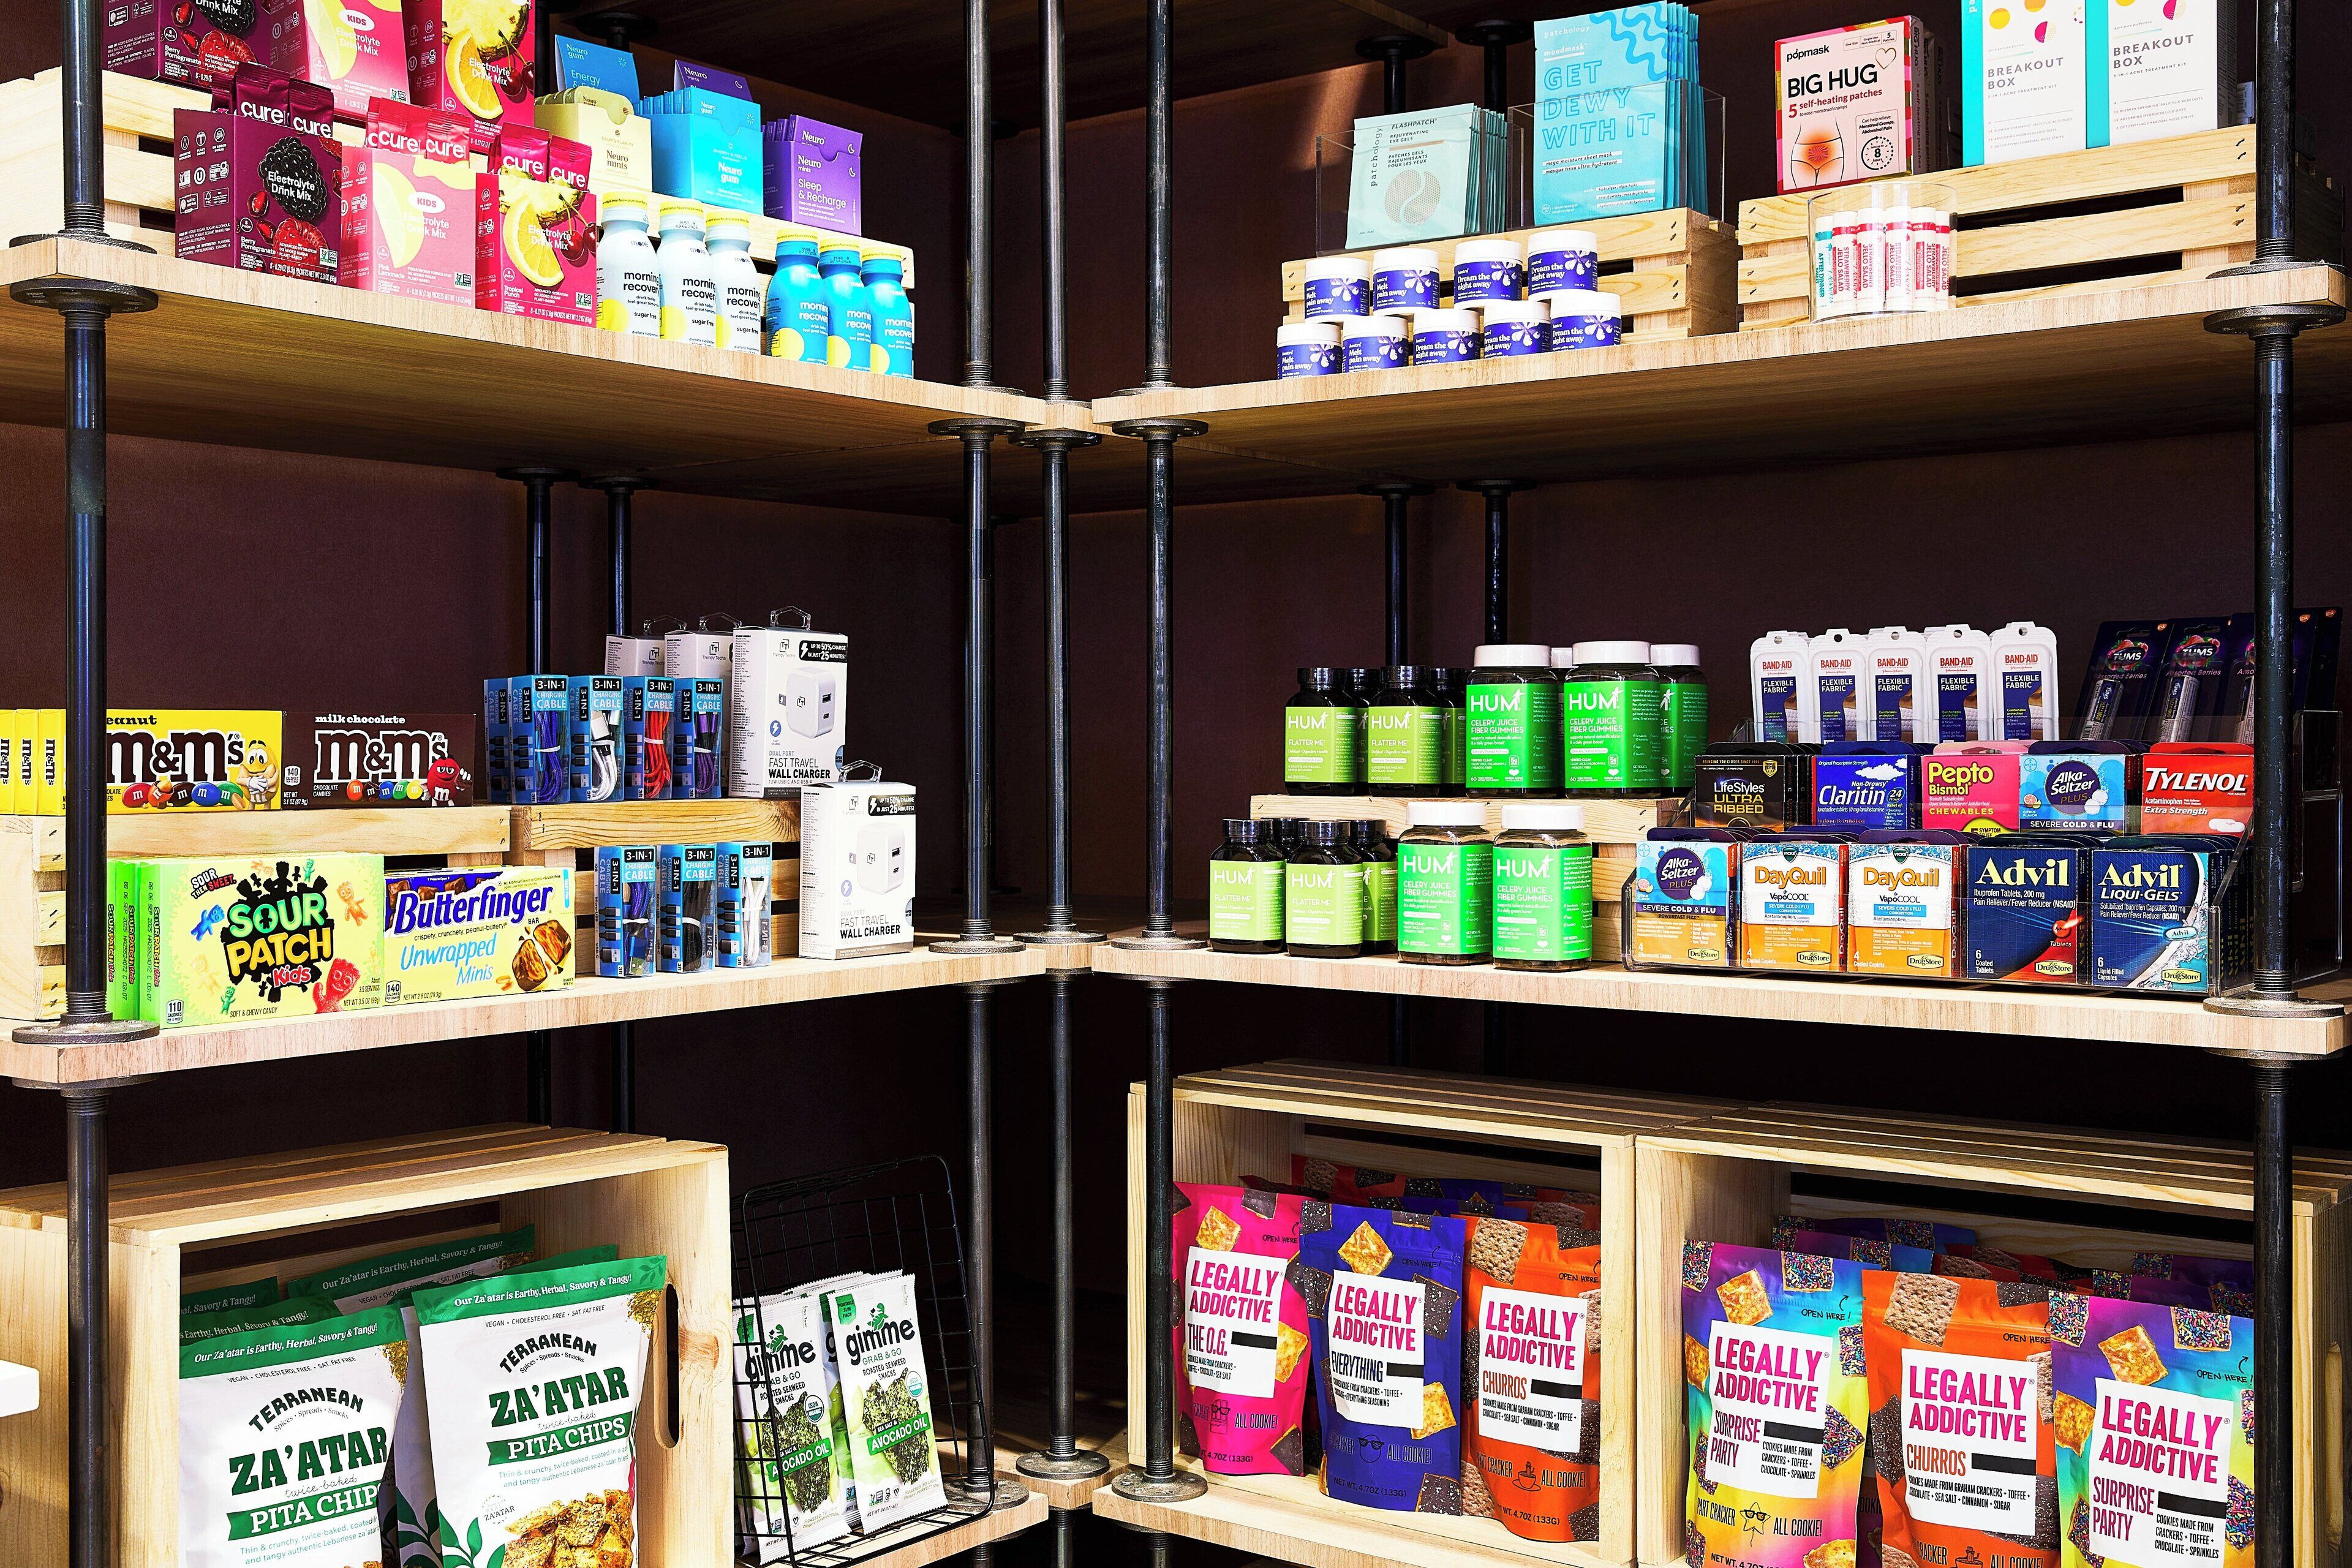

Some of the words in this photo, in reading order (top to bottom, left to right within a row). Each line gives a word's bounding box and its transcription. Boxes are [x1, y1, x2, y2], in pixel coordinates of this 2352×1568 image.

[1544, 25, 1590, 38] patchology
[567, 43, 588, 55] Neuro
[1544, 44, 1585, 56] moodmask
[1787, 45, 1830, 62] popmask
[2113, 33, 2195, 57] BREAKOUT
[568, 51, 584, 61] gum
[2113, 53, 2143, 69] BOX
[571, 70, 600, 85] Energy
[1544, 60, 1602, 91] GET
[1788, 74, 1822, 98] BIG
[1829, 64, 1877, 90] HUG
[1544, 86, 1633, 121] DEWY
[1789, 104, 1797, 118] 5
[1800, 94, 1848, 109] self-heating
[1850, 88, 1882, 102] patches
[241, 102, 284, 124] cure
[1392, 119, 1434, 129] FLASHPATCH
[1542, 118, 1616, 149] WITH
[1627, 113, 1656, 138] IT
[606, 149, 628, 162] Neuro
[1371, 128, 1383, 186] patchology
[1389, 154, 1428, 163] RAJEUNISSANTS
[1874, 148, 1881, 158] 8
[503, 155, 544, 175] cure
[607, 159, 628, 170] mints
[798, 156, 822, 168] Neuro
[798, 165, 811, 173] mints
[1578, 159, 1618, 170] ultra-hydratant
[268, 172, 315, 191] Electrolyte
[798, 178, 823, 194] Sleep
[271, 183, 295, 198] Drink
[296, 189, 312, 202] Mix
[798, 190, 807, 199] &
[807, 190, 846, 209] Recharge
[417, 197, 437, 208] KIDS
[241, 237, 257, 246] Berry
[241, 243, 276, 255] Pomegranate
[504, 285, 524, 294] Tropical
[504, 290, 520, 299] Punch
[1763, 661, 1792, 670] BAND-AID
[537, 680, 565, 691] 3-IN-1
[537, 699, 566, 709] CABLE
[1471, 692, 1519, 712] HUM
[347, 715, 405, 725] chocolate
[769, 759, 791, 768] FAST
[794, 758, 818, 768] TRAVEL
[769, 769, 791, 778] WALL
[793, 768, 830, 779] CHARGER
[1929, 763, 1995, 789] Pepto
[2146, 768, 2245, 791] TYLENOL
[1714, 782, 1764, 794] LifeStyles
[1819, 786, 1885, 805] Claritin
[1929, 782, 1968, 795] Bismol
[1714, 794, 1763, 804] ULTRA
[1714, 804, 1763, 813] RIBBED
[2145, 807, 2166, 815] Extra
[2168, 807, 2207, 816] Strength
[1665, 857, 1692, 869] Alka-
[1975, 856, 2069, 886] Advil
[190, 869, 217, 888] SOUR
[1662, 867, 1697, 879] Seltzer
[1755, 866, 1826, 886] DayQuil
[2098, 863, 2180, 888] Advil
[1670, 880, 1693, 889] PLUS
[191, 888, 208, 899] THEN
[1974, 889, 1999, 898] Ibuprofen
[228, 893, 326, 937] SOUR
[394, 886, 552, 935] Butterfinger
[225, 934, 331, 977] PATCH
[401, 933, 497, 971] Unwrapped
[1910, 958, 1942, 967] DrugStore
[273, 967, 312, 987] Kids
[456, 965, 494, 986] Minis
[168, 1002, 181, 1012] 110
[1262, 1234, 1280, 1243] OPEN
[1191, 1260, 1279, 1297] LEGALLY
[454, 1297, 472, 1307] Our
[514, 1287, 541, 1299] Earthy,
[541, 1283, 568, 1294] Herbal,
[569, 1279, 598, 1292] Savory
[607, 1274, 632, 1286] Tangy!
[1189, 1290, 1272, 1323] ADDICTIVE
[846, 1317, 915, 1365] gimme
[1187, 1323, 1204, 1352] THE
[1206, 1328, 1227, 1356] O.G.
[499, 1333, 597, 1373] TERRANEAN
[863, 1363, 884, 1376] ROASTED
[886, 1358, 906, 1370] SEAWEED
[1332, 1351, 1383, 1382] EVERYTHING
[1483, 1370, 1527, 1400] CHURROS
[872, 1424, 911, 1451] AVOCADO
[913, 1416, 927, 1434] OIL
[1714, 1410, 1761, 1444] SURPRISE
[508, 1436, 563, 1460] PITA
[565, 1417, 627, 1448] CHIPS
[1710, 1438, 1738, 1468] PARTY
